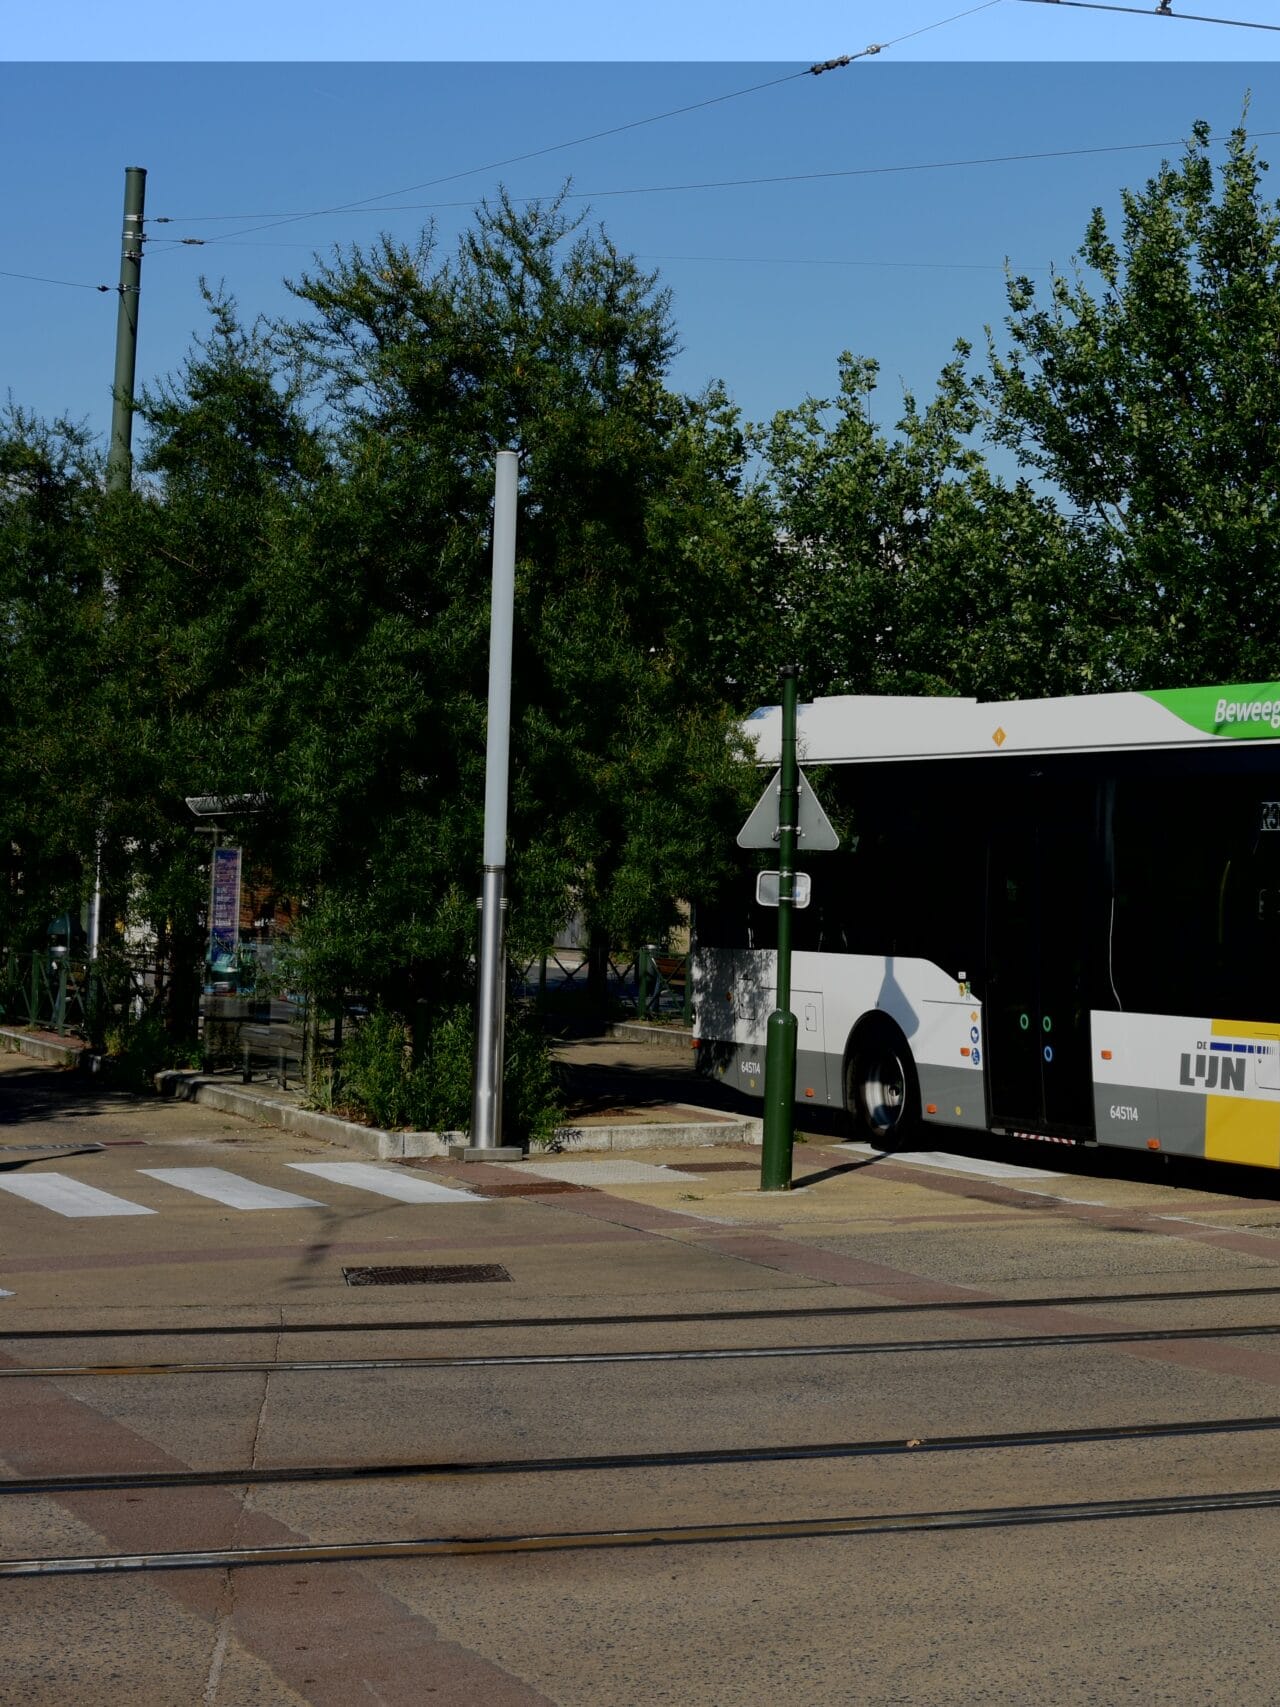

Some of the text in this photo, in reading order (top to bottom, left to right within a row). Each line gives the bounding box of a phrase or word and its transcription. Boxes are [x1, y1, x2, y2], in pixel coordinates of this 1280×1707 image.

[1196, 1040, 1208, 1050] DE
[741, 1061, 761, 1075] 645114
[1179, 1052, 1247, 1092] LIJN
[1109, 1104, 1139, 1121] 645114
